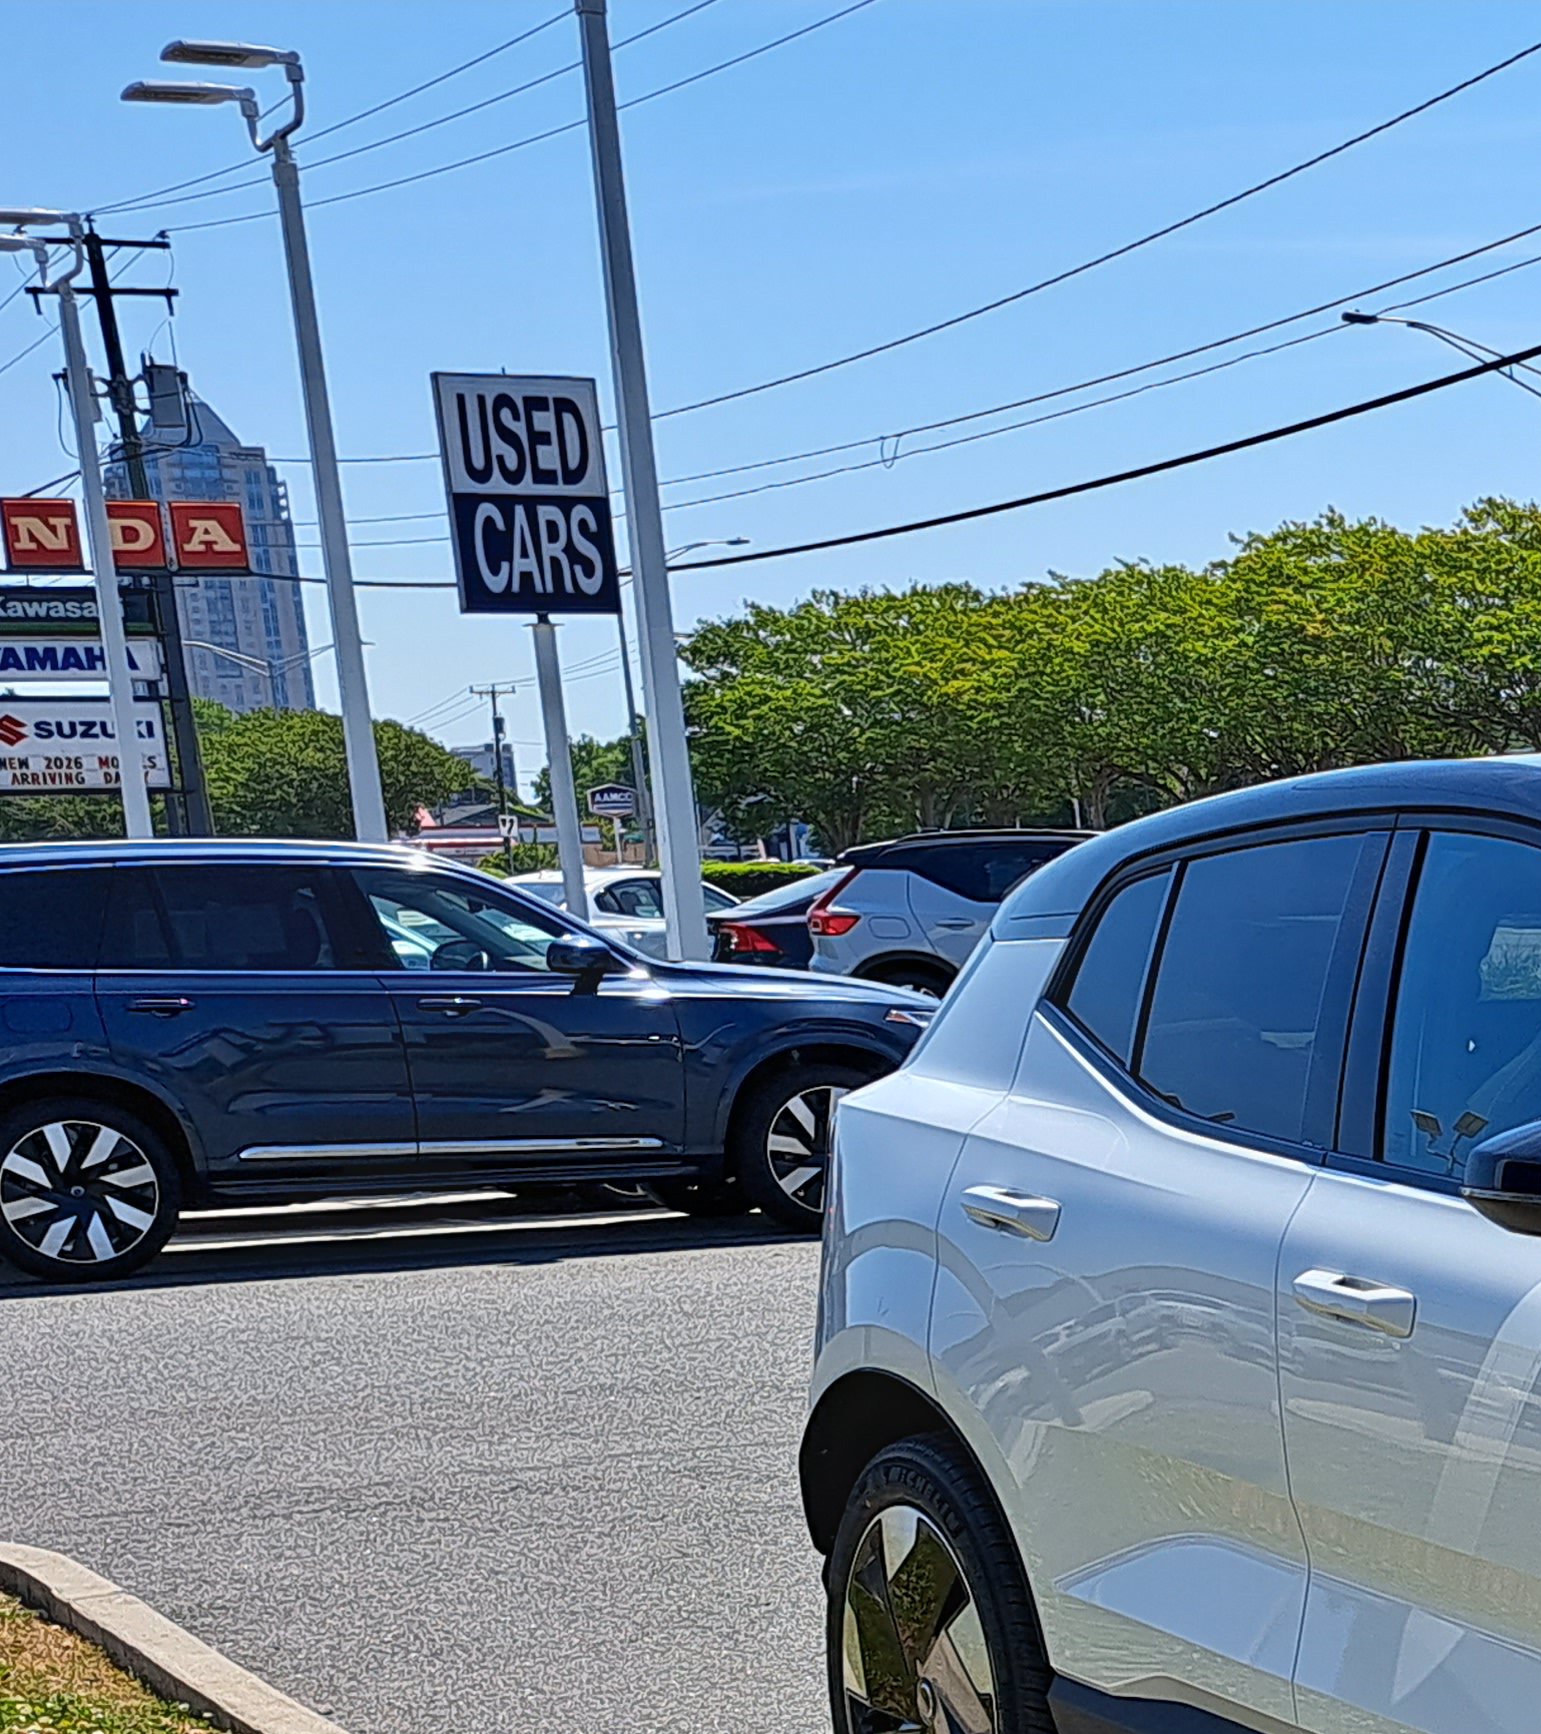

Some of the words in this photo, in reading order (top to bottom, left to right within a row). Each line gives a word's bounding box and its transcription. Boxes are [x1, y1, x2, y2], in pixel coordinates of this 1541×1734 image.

[456, 393, 589, 486] USED
[474, 502, 603, 595] CARS
[11, 772, 85, 785] ARRIVING
[44, 756, 83, 769] 2026
